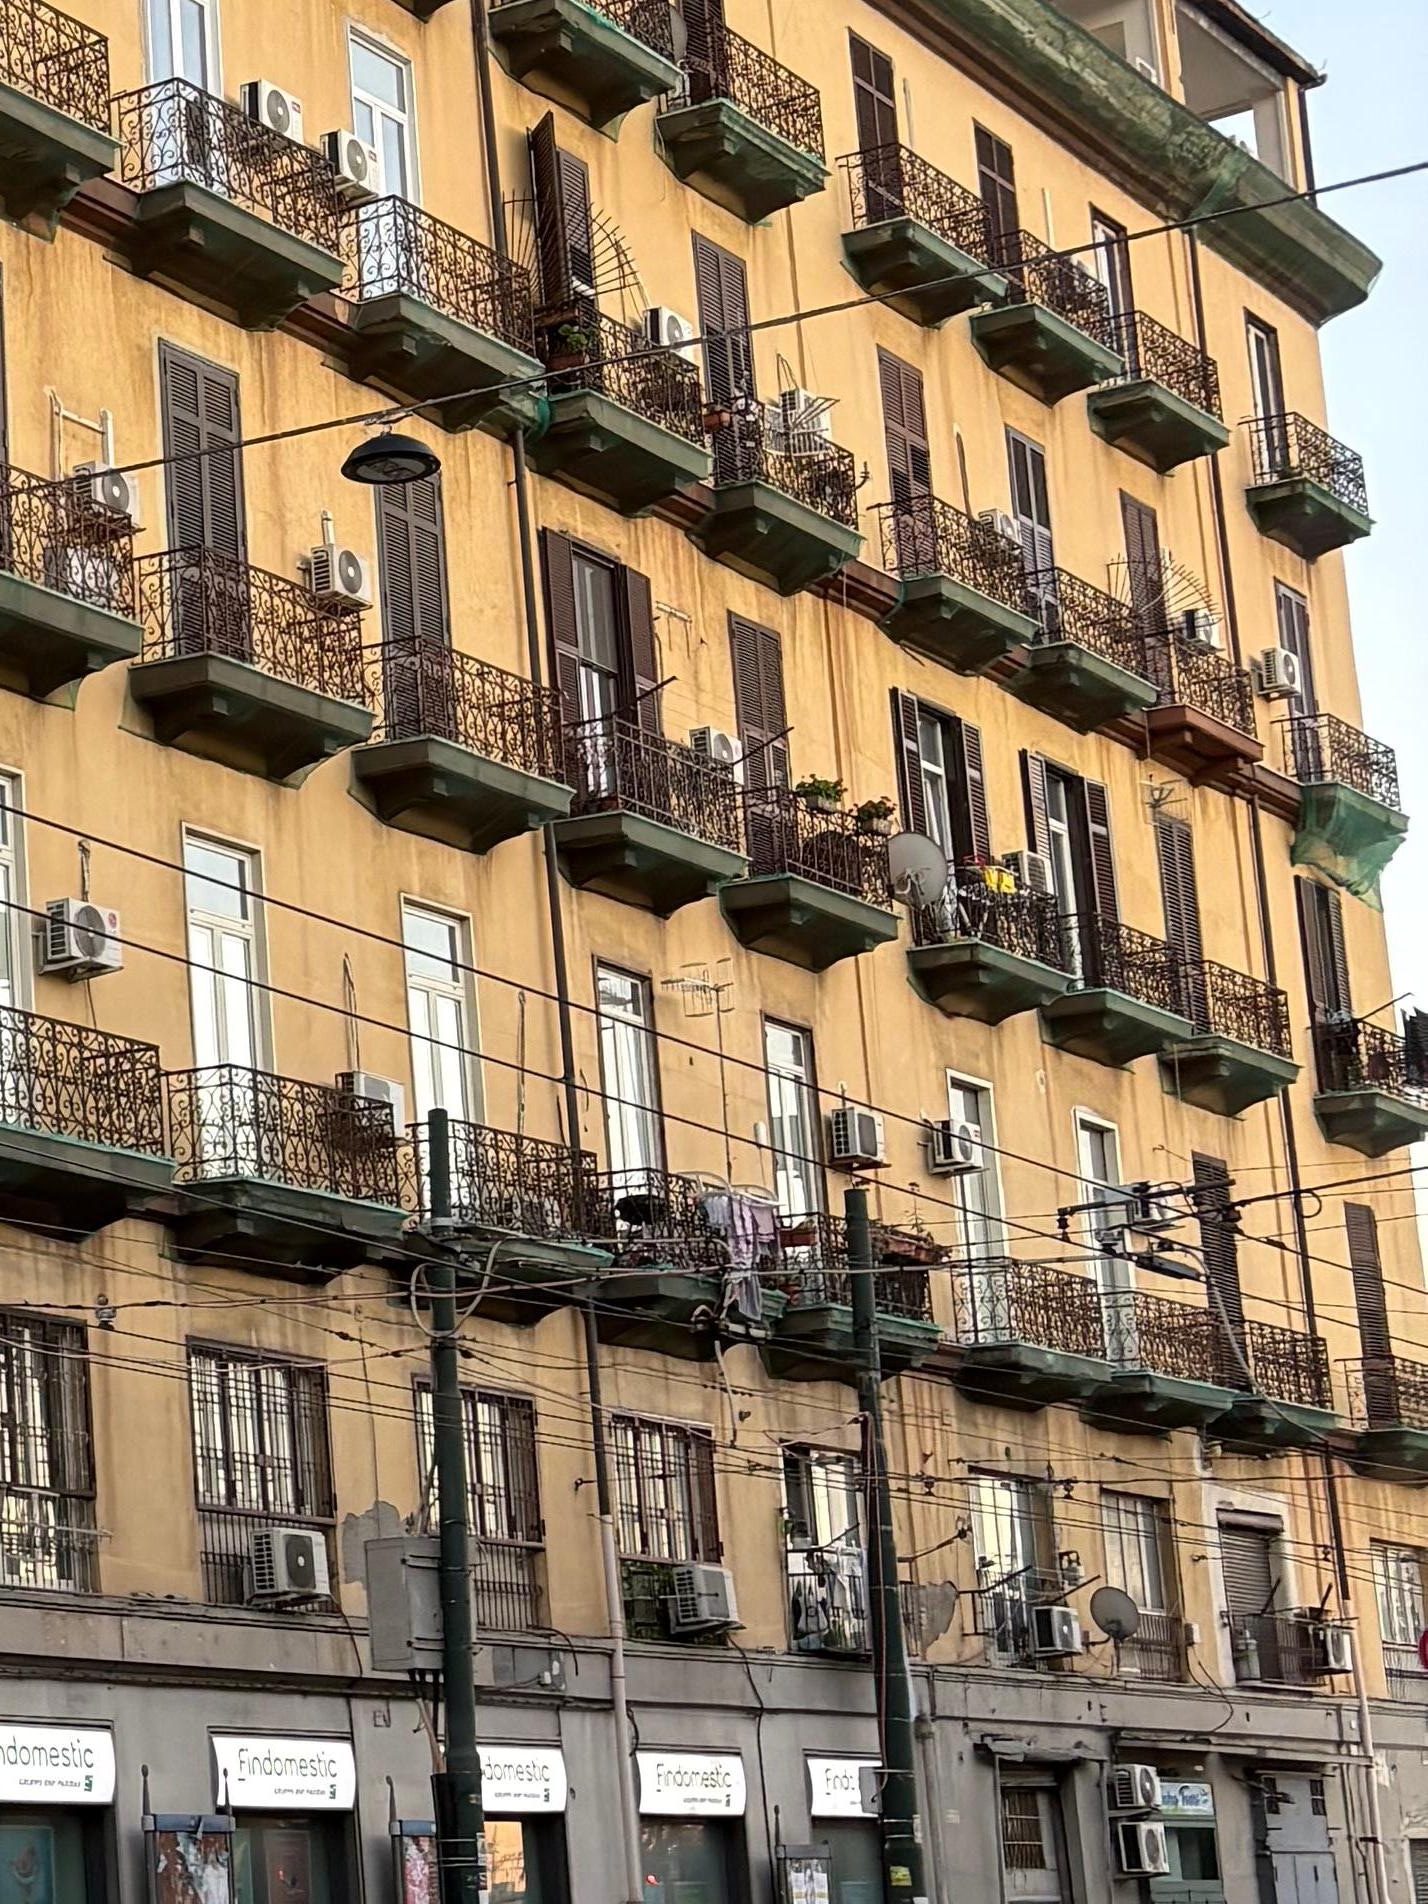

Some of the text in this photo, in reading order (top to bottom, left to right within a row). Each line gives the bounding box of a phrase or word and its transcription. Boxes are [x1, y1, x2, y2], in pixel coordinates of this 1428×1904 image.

[238, 1748, 337, 1778] Findomestic
[484, 1755, 550, 1782] domestic
[656, 1763, 732, 1789] Findomestic
